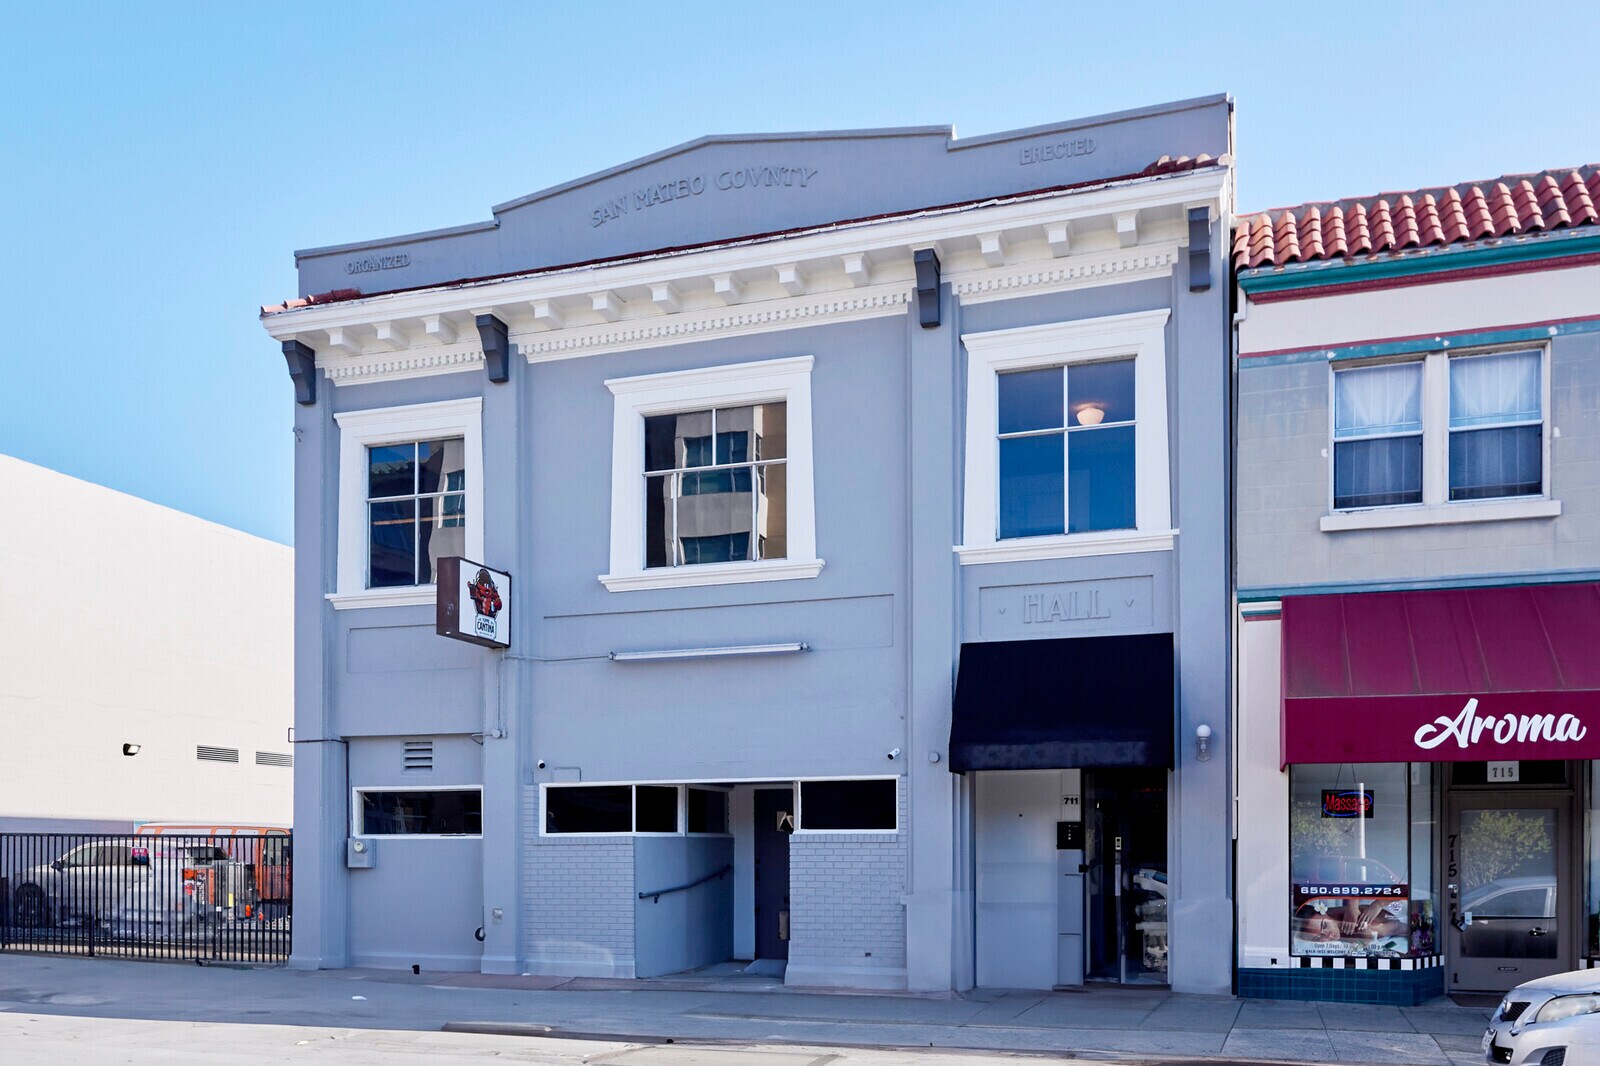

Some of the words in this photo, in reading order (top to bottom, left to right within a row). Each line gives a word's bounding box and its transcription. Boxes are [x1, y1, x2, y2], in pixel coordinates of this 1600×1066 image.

[1019, 138, 1097, 165] ERECTED
[591, 195, 628, 228] SAN
[634, 175, 704, 211] MATEO
[345, 254, 411, 275] ORGANIZED
[1022, 589, 1111, 625] HALL
[477, 621, 495, 634] CANTINA
[1414, 697, 1587, 749] Aroma
[1492, 767, 1514, 778] 715
[1064, 796, 1079, 805] 711
[1325, 793, 1370, 814] Massage
[1448, 834, 1458, 878] 715
[1300, 886, 1402, 895] 650.699.2724
